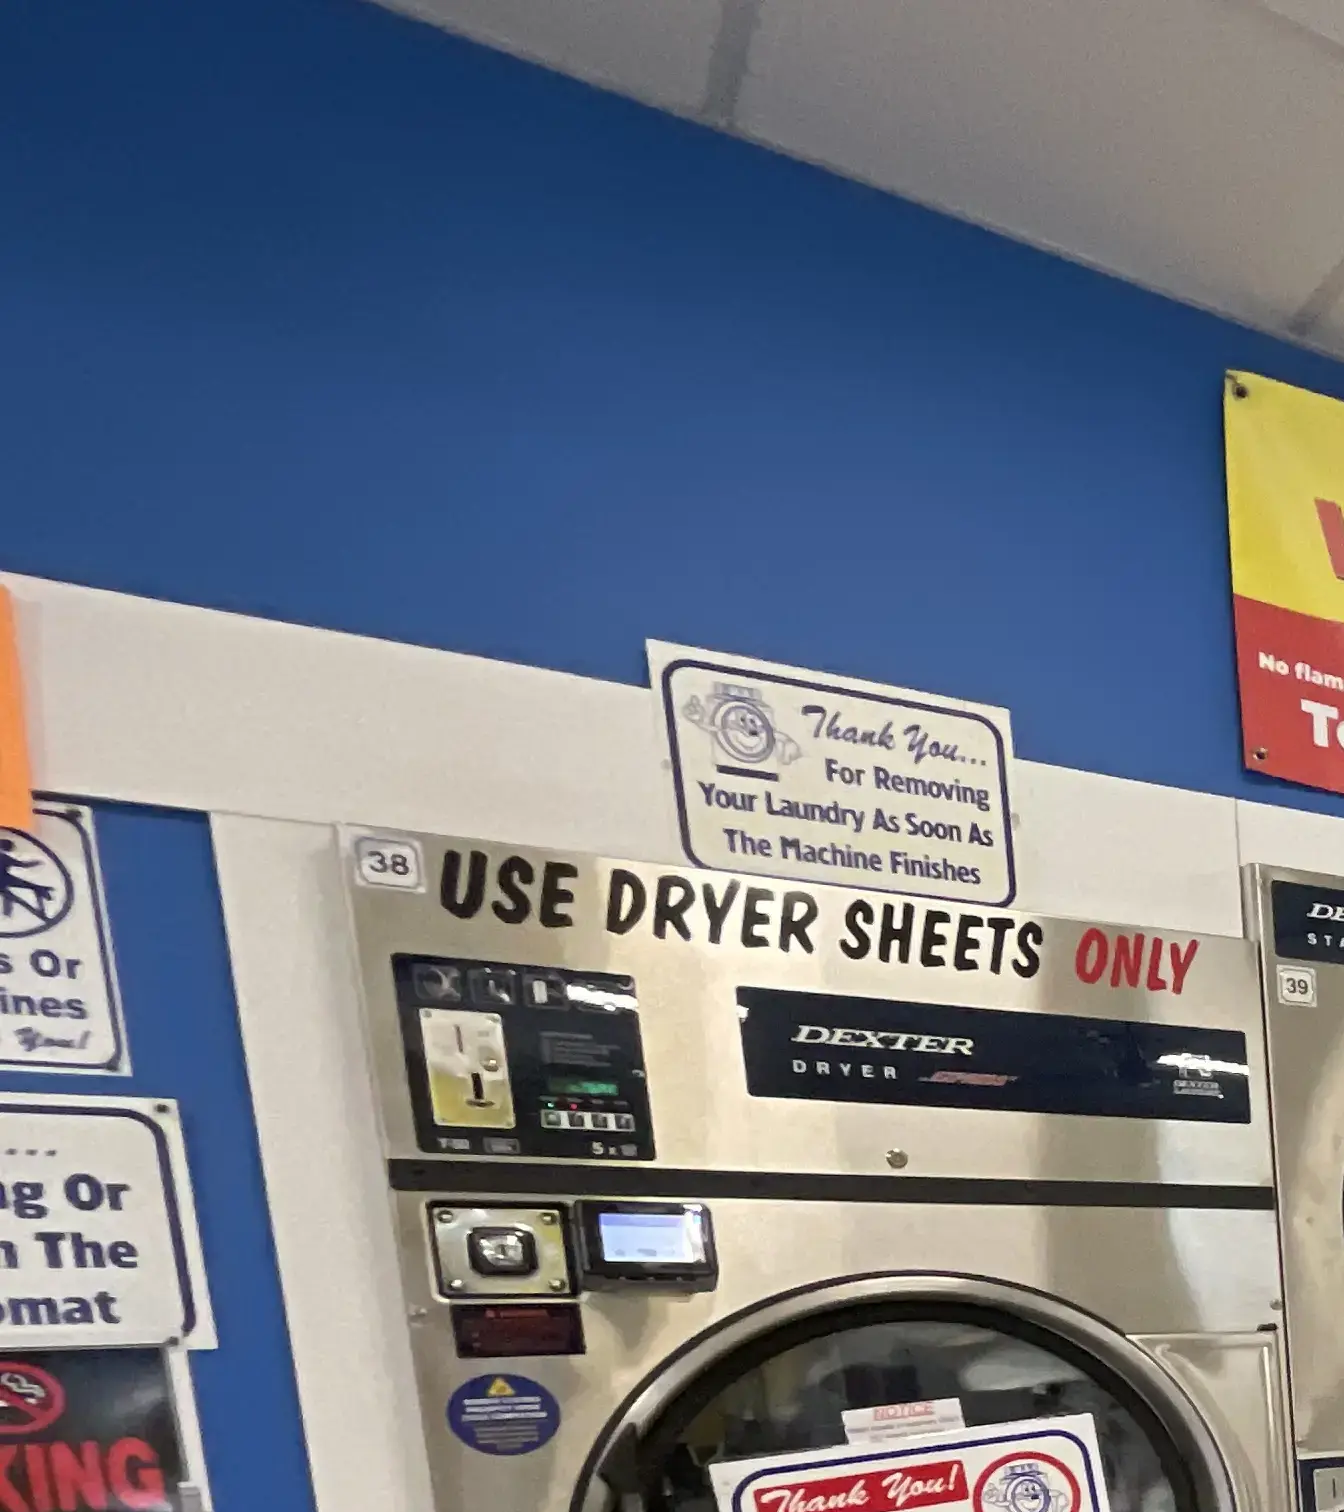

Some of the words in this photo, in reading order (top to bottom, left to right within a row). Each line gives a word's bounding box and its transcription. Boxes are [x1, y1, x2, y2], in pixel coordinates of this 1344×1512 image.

[1258, 651, 1290, 676] No
[801, 704, 896, 750] Thank
[904, 724, 987, 766] You...
[824, 758, 866, 786] For
[874, 766, 989, 812] Removing
[697, 780, 758, 812] Your
[765, 790, 865, 833] Laundry
[873, 810, 900, 833] As
[905, 812, 962, 843] Soon
[968, 822, 994, 847] As
[367, 851, 409, 876] 38
[723, 827, 773, 858] The
[780, 835, 882, 872] Machine
[890, 850, 982, 885] Finishes
[440, 849, 578, 928] USE
[606, 867, 818, 954] DRYER
[839, 899, 1043, 978] SHEETS
[1075, 926, 1198, 994] ONLY
[30, 948, 83, 979] Or
[1286, 977, 1309, 995] 39
[790, 1024, 975, 1056] DEXTER
[792, 1059, 898, 1080] DRYER
[64, 1173, 130, 1211] Or
[34, 1232, 138, 1269] The
[873, 1401, 934, 1421] NOTICE
[882, 1463, 956, 1507] You!
